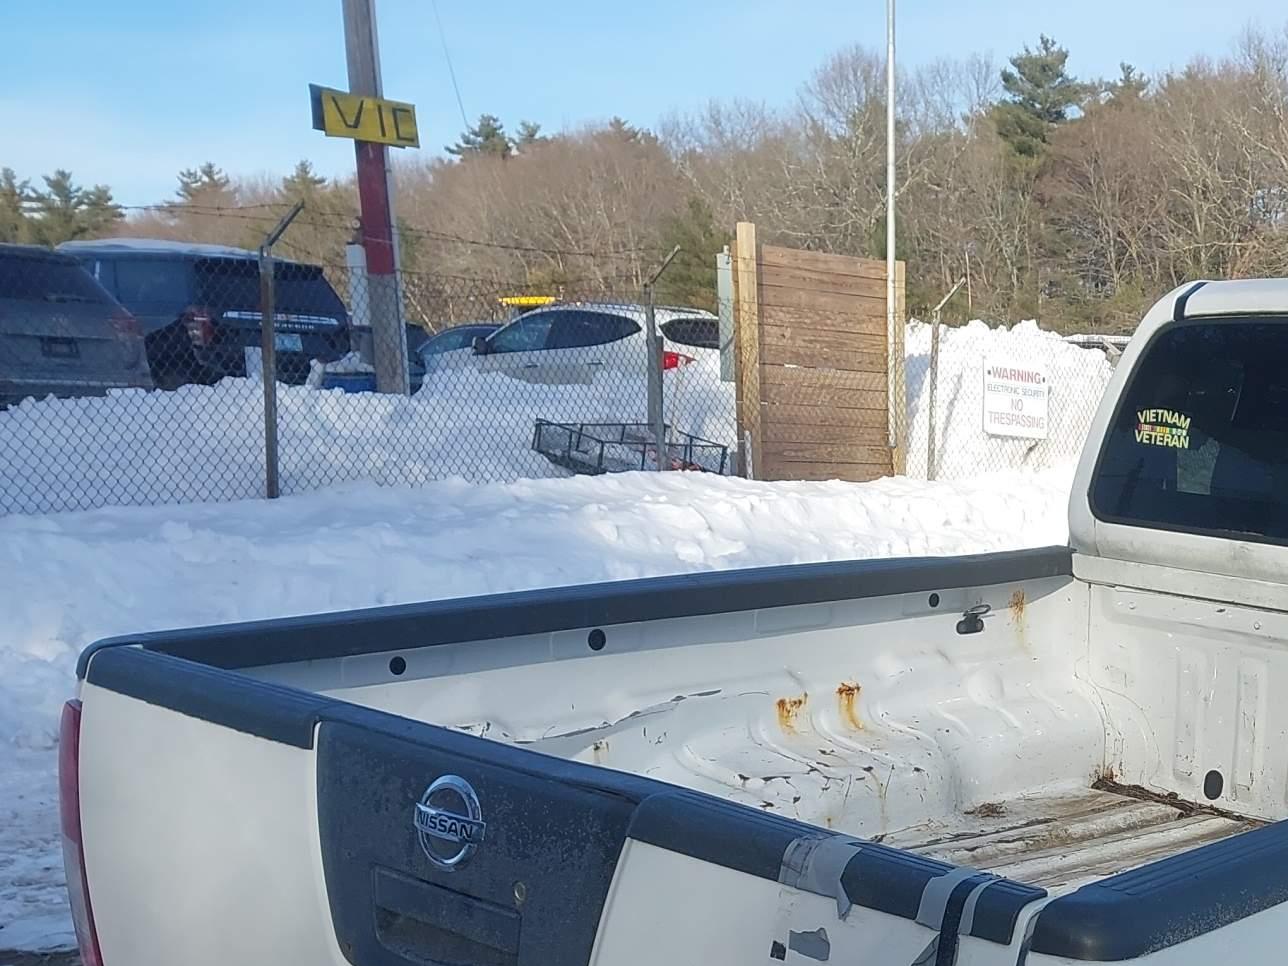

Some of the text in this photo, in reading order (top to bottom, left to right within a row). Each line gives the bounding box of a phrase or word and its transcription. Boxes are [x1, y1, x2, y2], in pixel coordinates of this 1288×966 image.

[991, 366, 1041, 384] WARNING
[1011, 398, 1023, 411] NO
[988, 411, 1044, 429] TRESPASSING
[1137, 408, 1191, 430] VIETNAM
[1134, 429, 1189, 448] VETERAN
[416, 809, 473, 839] NISSAN
